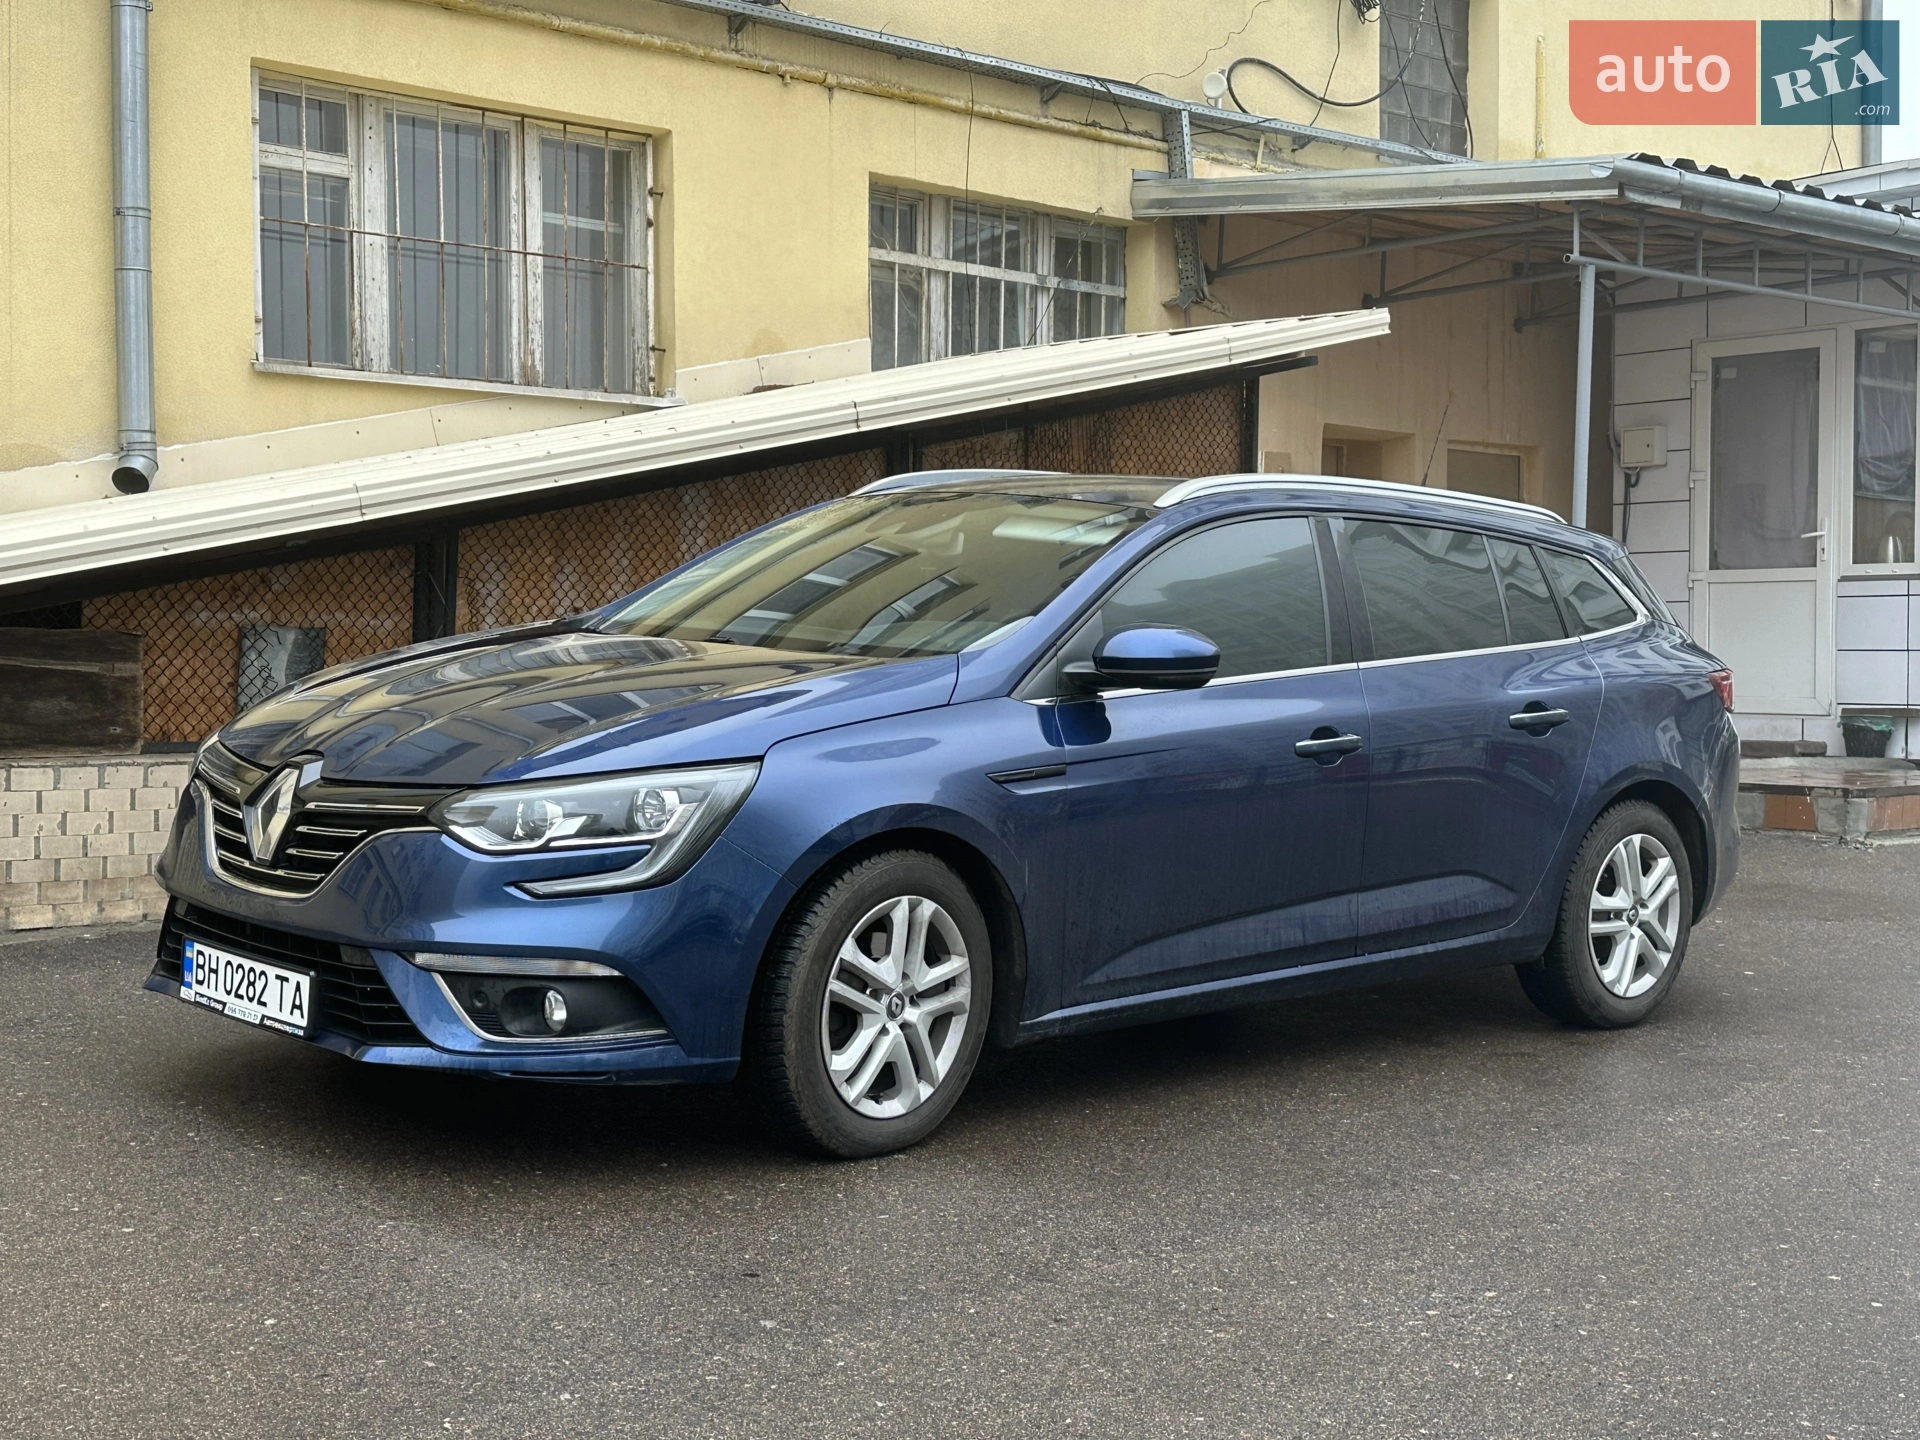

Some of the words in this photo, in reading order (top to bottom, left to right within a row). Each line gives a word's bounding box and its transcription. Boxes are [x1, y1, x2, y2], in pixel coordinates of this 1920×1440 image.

[195, 949, 219, 992] BH
[223, 960, 269, 1008] 0282
[275, 974, 305, 1020] TA
